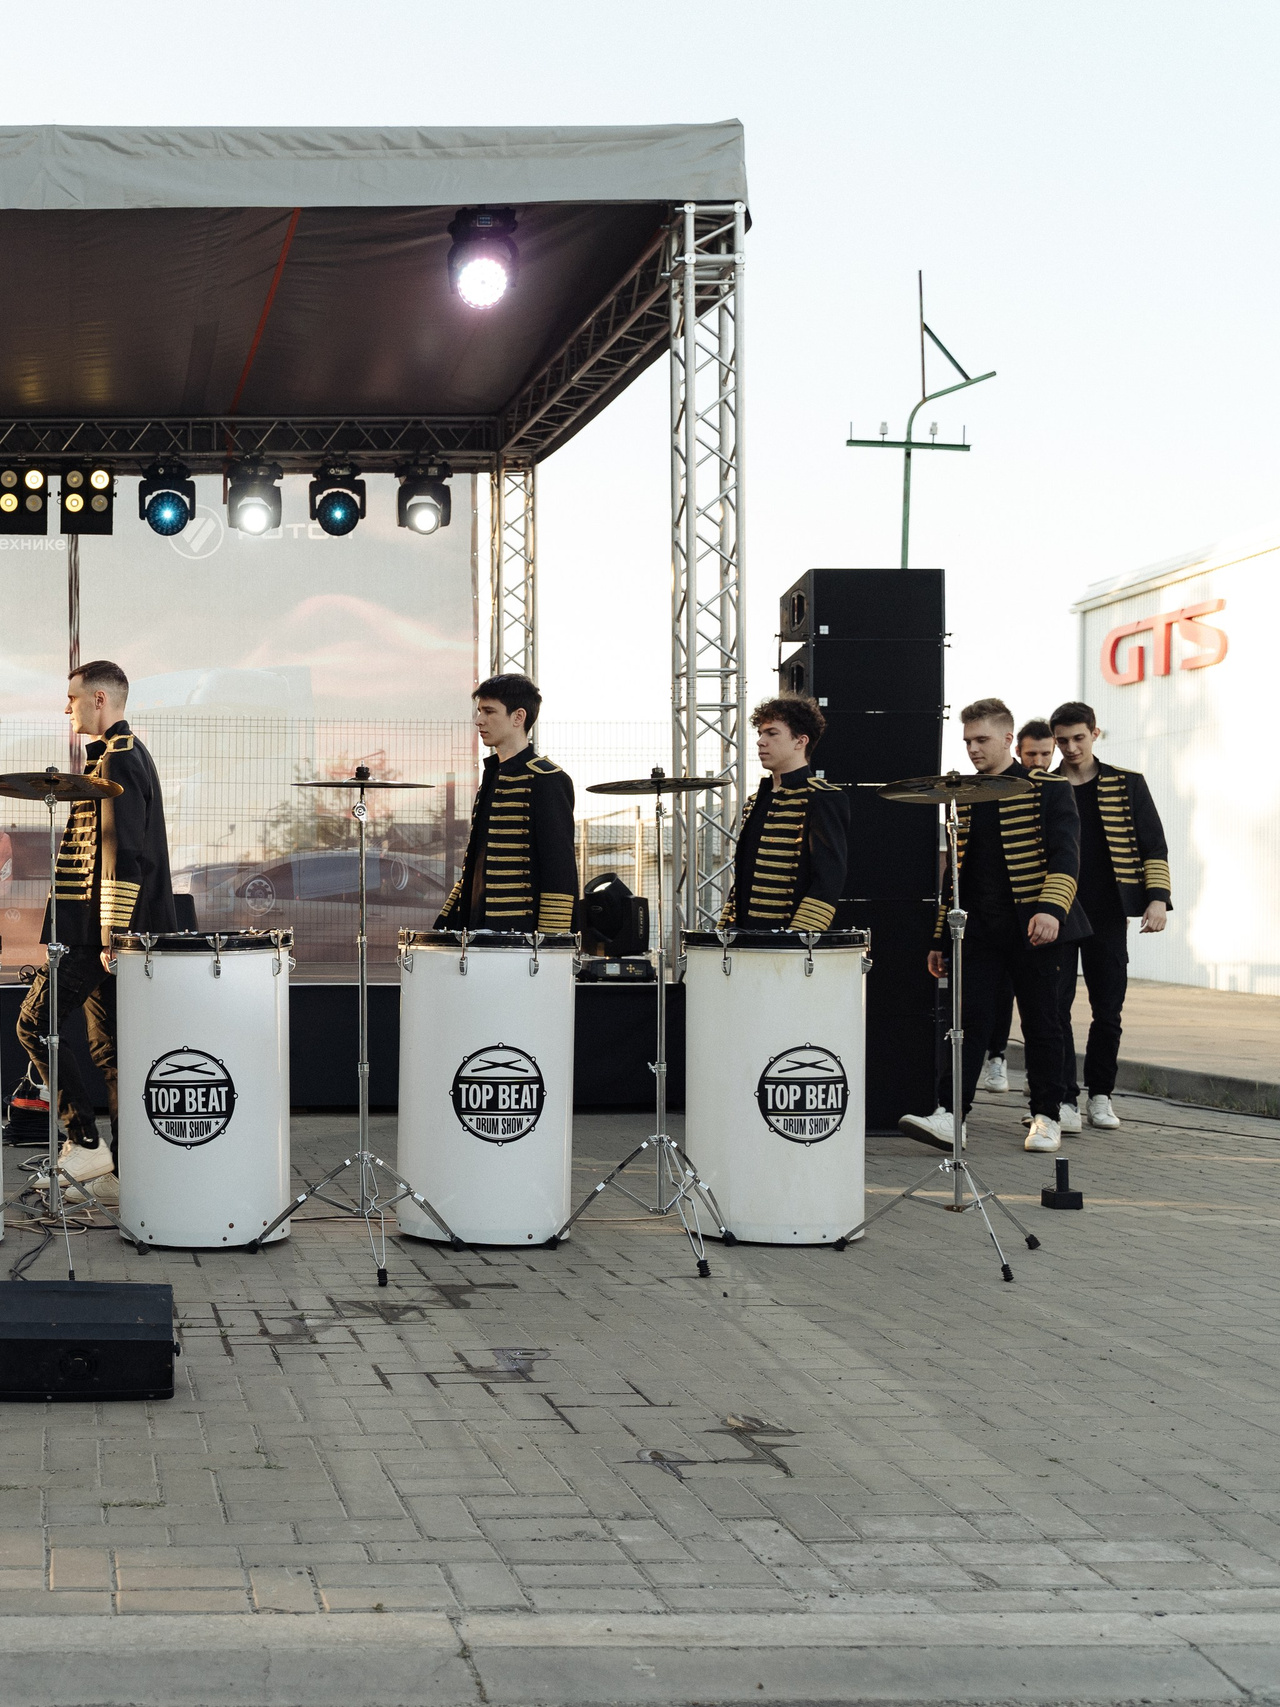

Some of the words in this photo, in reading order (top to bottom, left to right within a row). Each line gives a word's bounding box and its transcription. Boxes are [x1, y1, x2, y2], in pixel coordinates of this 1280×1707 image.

[1101, 598, 1229, 686] GTS
[149, 1087, 181, 1113] TOP
[184, 1086, 229, 1113] BEAT
[458, 1084, 494, 1109] TOP
[498, 1084, 539, 1110] BEAT
[764, 1084, 801, 1110] TOP
[805, 1083, 844, 1110] BEAT
[165, 1120, 187, 1138] DRUM
[189, 1120, 212, 1138] SHOW
[476, 1117, 499, 1135] DRUM
[501, 1117, 524, 1135] SHOW
[783, 1118, 807, 1135] DRUM
[809, 1117, 830, 1135] SHOW
